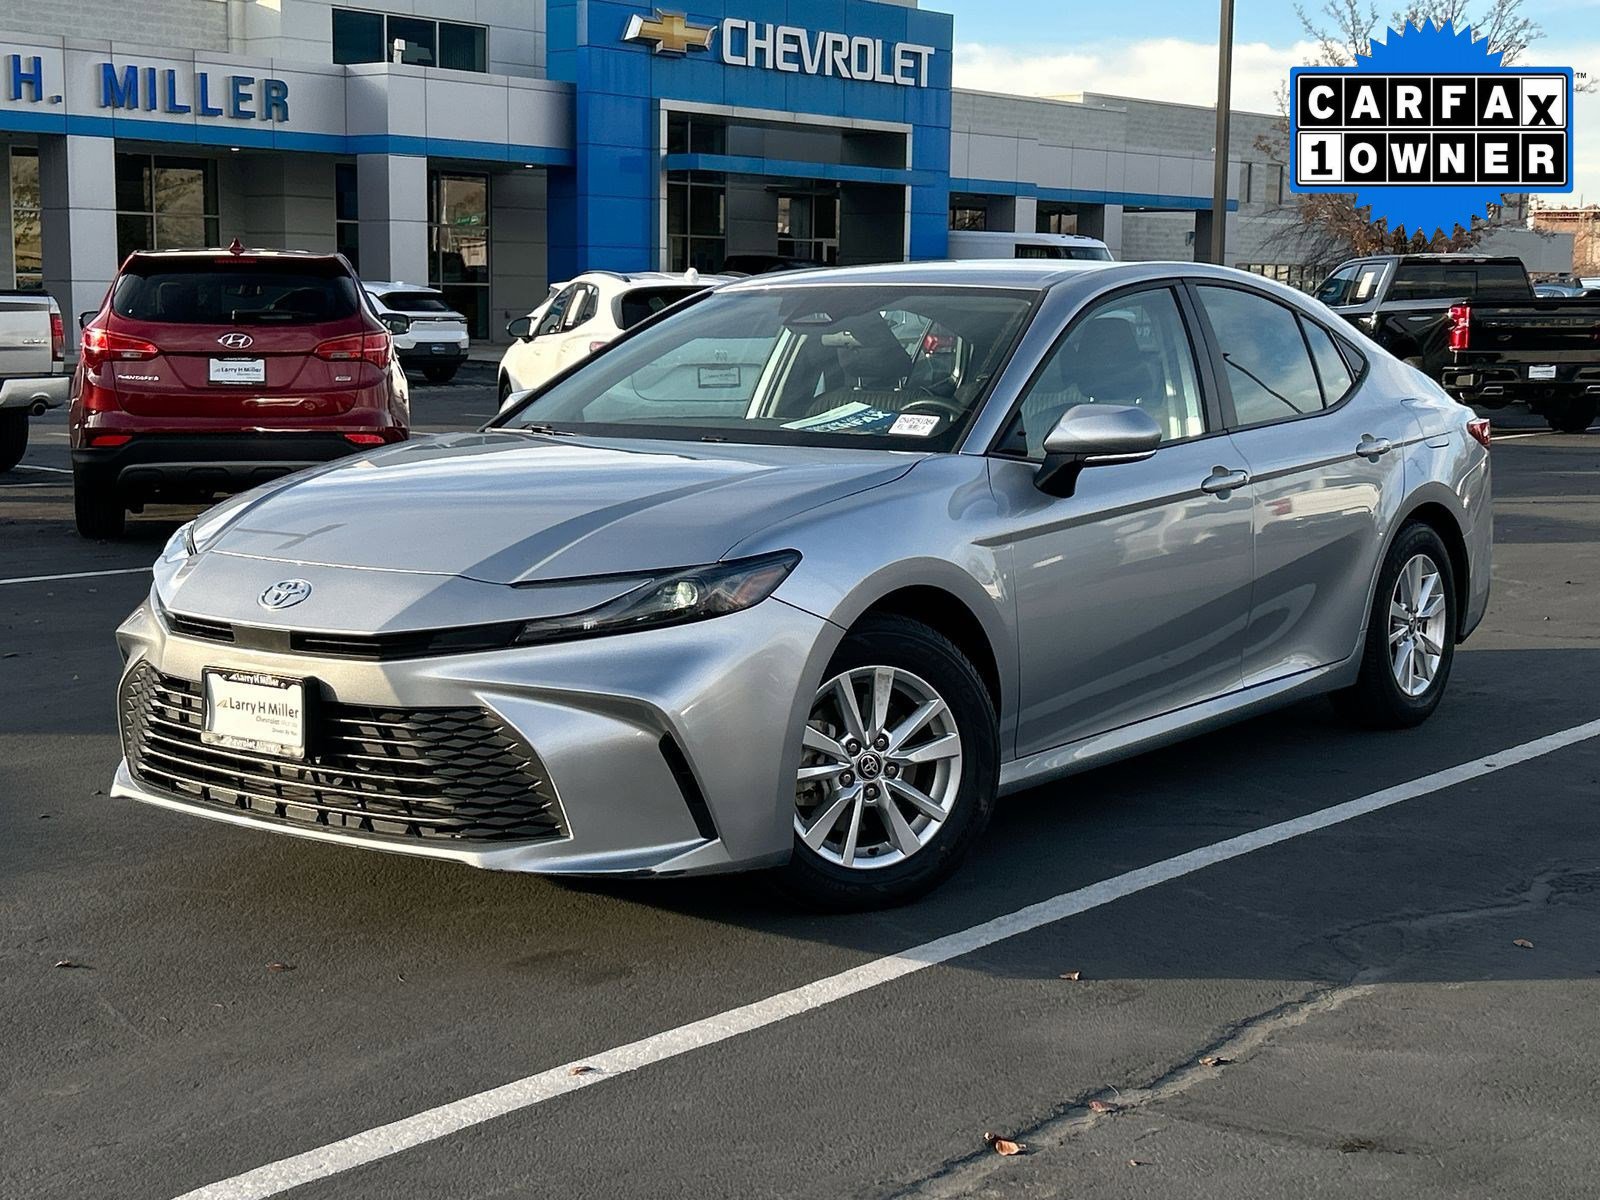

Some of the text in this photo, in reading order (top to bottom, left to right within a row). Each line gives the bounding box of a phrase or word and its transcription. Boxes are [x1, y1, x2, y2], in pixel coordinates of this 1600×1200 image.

[722, 18, 935, 88] CHEVROLET
[9, 54, 290, 122] H. MILLER
[229, 697, 299, 718] Larry H Miller
